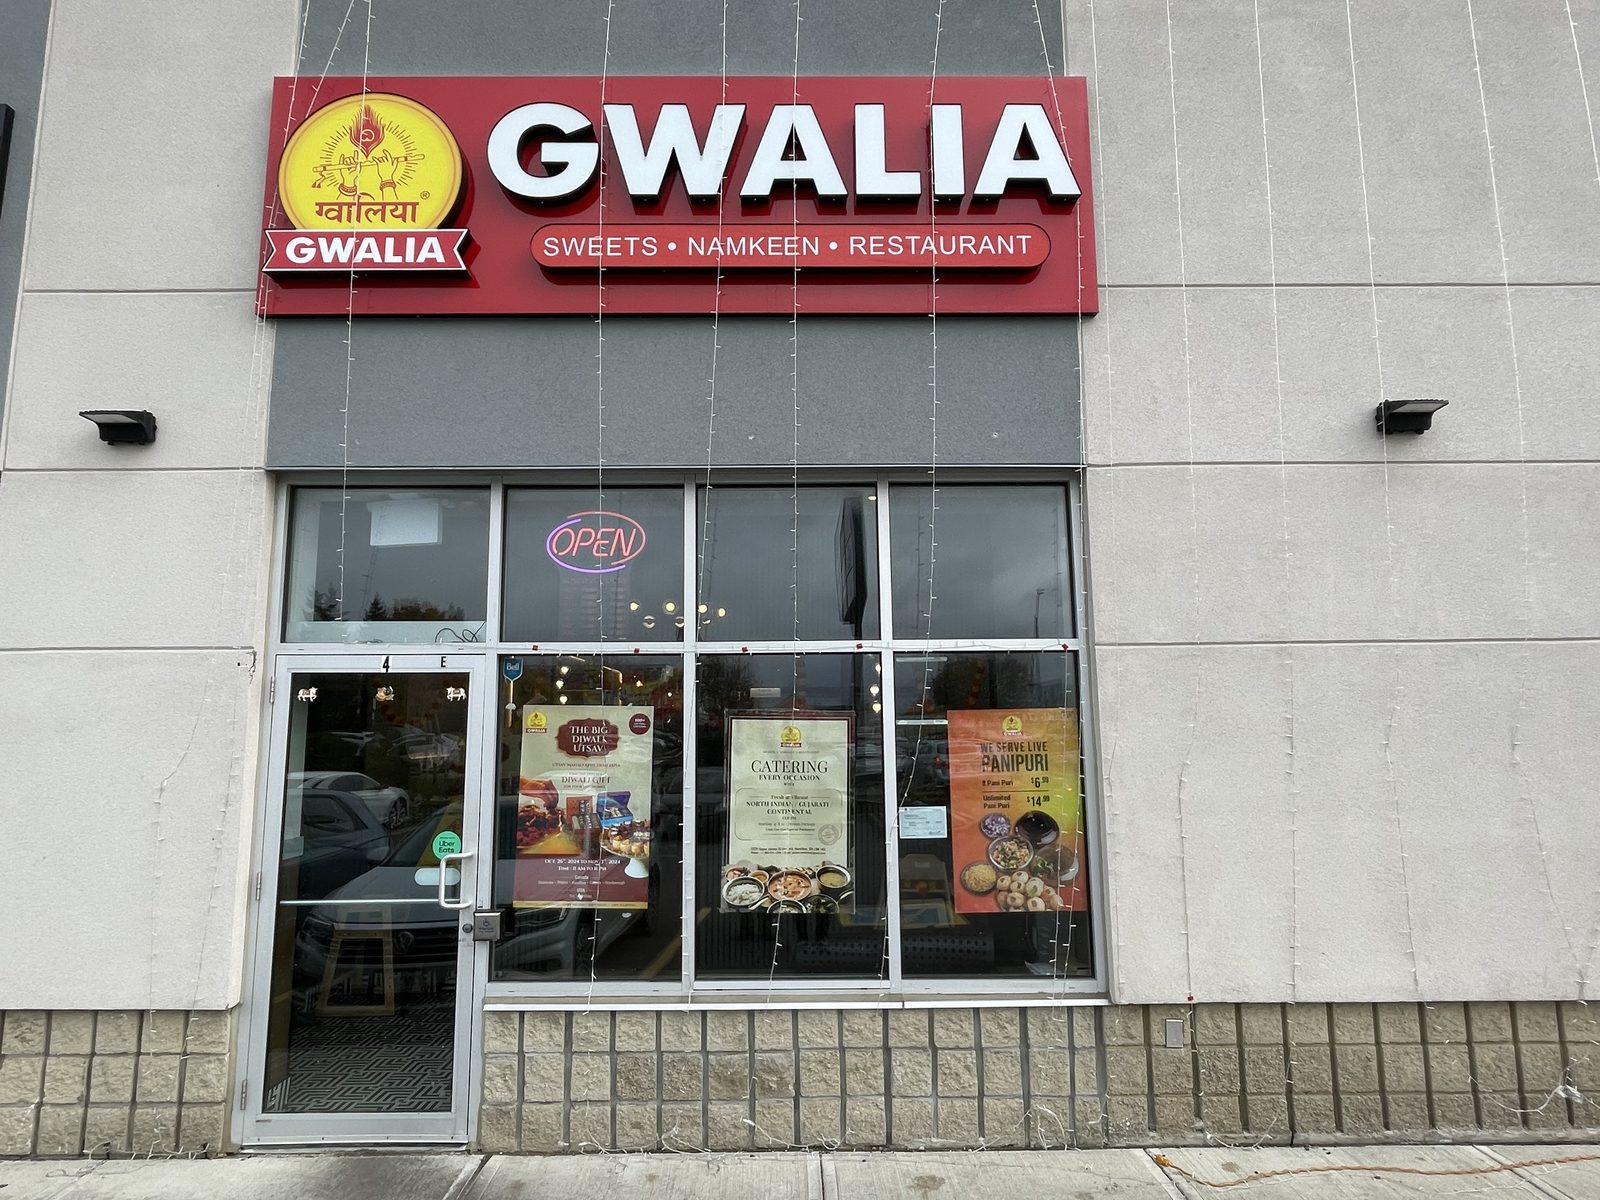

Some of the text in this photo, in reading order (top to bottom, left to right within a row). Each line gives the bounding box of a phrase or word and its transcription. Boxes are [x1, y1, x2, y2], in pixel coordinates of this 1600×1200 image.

[487, 102, 1081, 198] GWALIA
[315, 192, 420, 224] ग्वालिया
[285, 236, 446, 264] GWALIA
[543, 235, 1032, 257] SWEETS NAMKEEN RESTAURANT
[551, 527, 637, 557] OPEN
[382, 655, 390, 673] 4
[440, 656, 447, 668] E
[506, 662, 520, 671] Bell
[569, 726, 608, 734] THE BIG
[573, 744, 606, 752] UTSAV
[981, 741, 1048, 753] WE SERVE LIVE
[751, 759, 828, 774] CATERING
[982, 753, 1049, 772] PANIPURI
[438, 840, 456, 848] Uber
